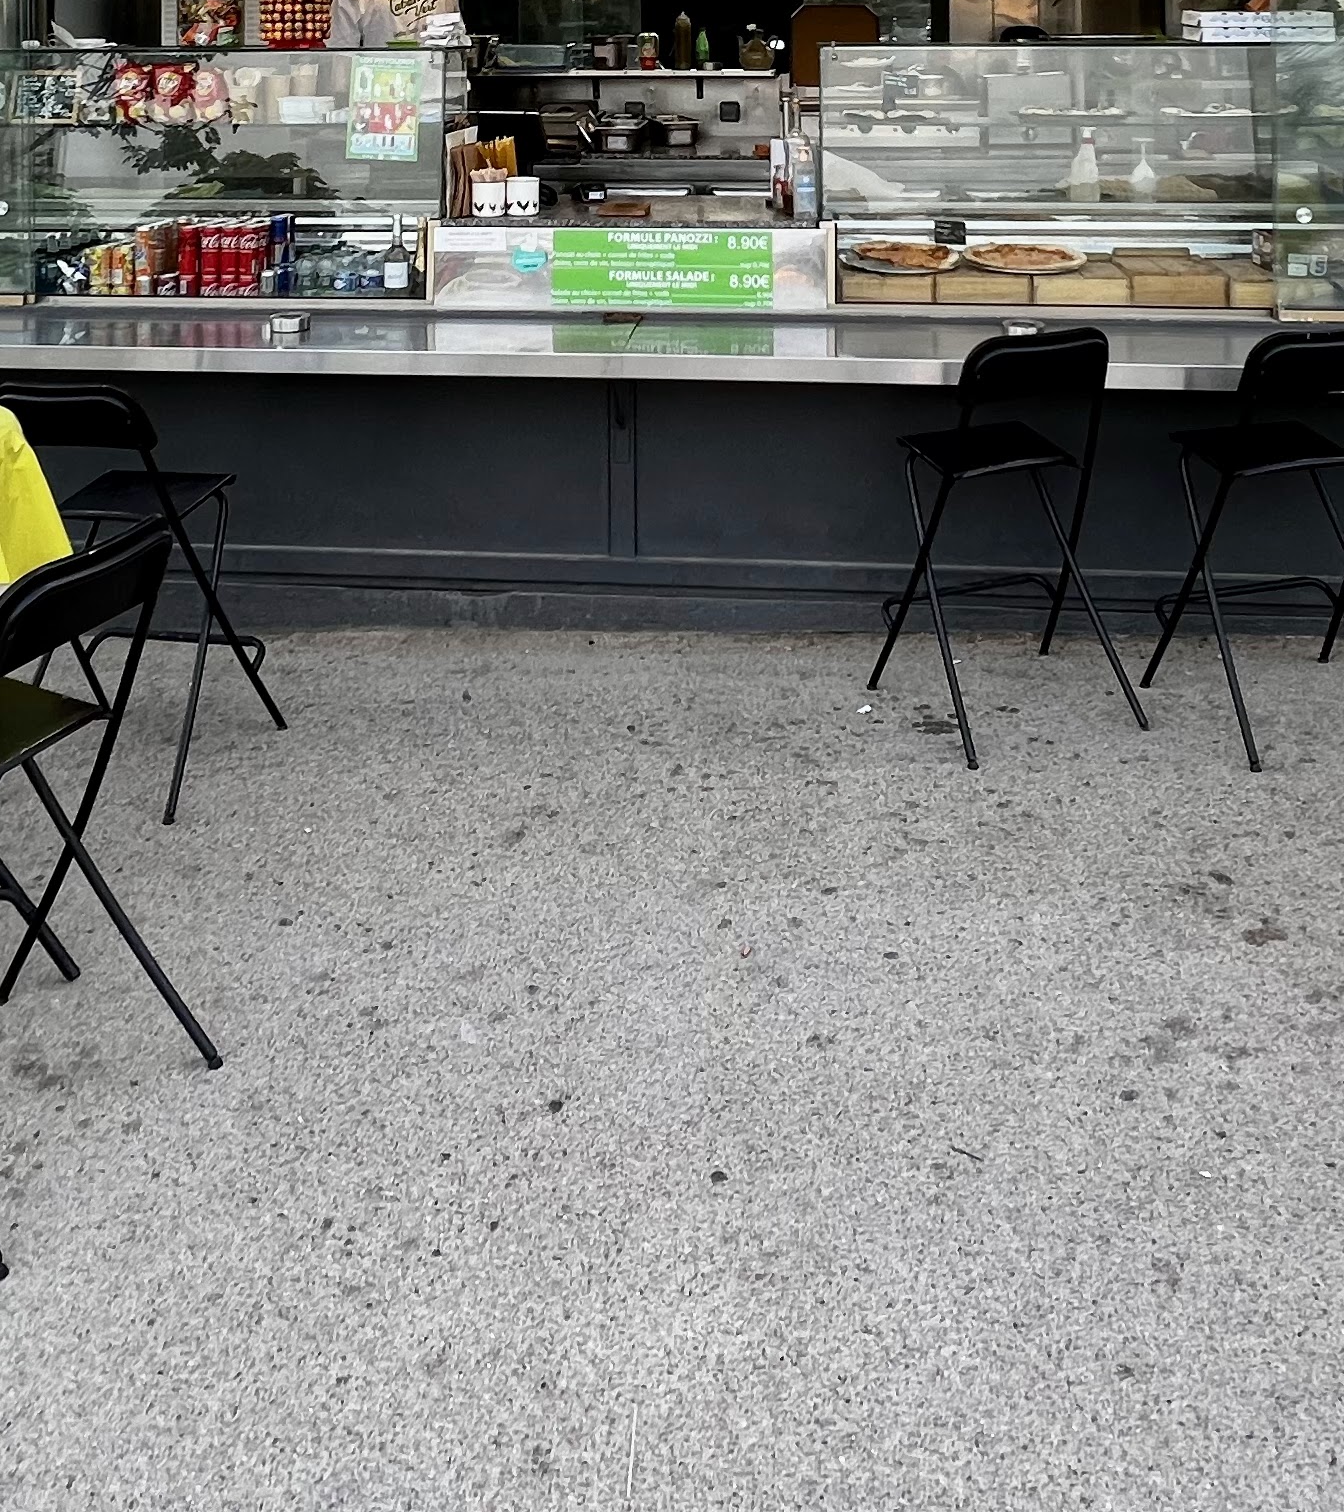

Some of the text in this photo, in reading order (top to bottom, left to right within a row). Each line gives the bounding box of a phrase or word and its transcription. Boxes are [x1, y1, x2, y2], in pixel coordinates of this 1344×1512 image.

[607, 232, 662, 243] FORMULE
[663, 232, 713, 244] PANOZZI
[727, 235, 769, 250] 8.90€
[608, 270, 664, 281] FORMULE
[665, 270, 710, 282] SALADE
[729, 273, 770, 289] 8.90€
